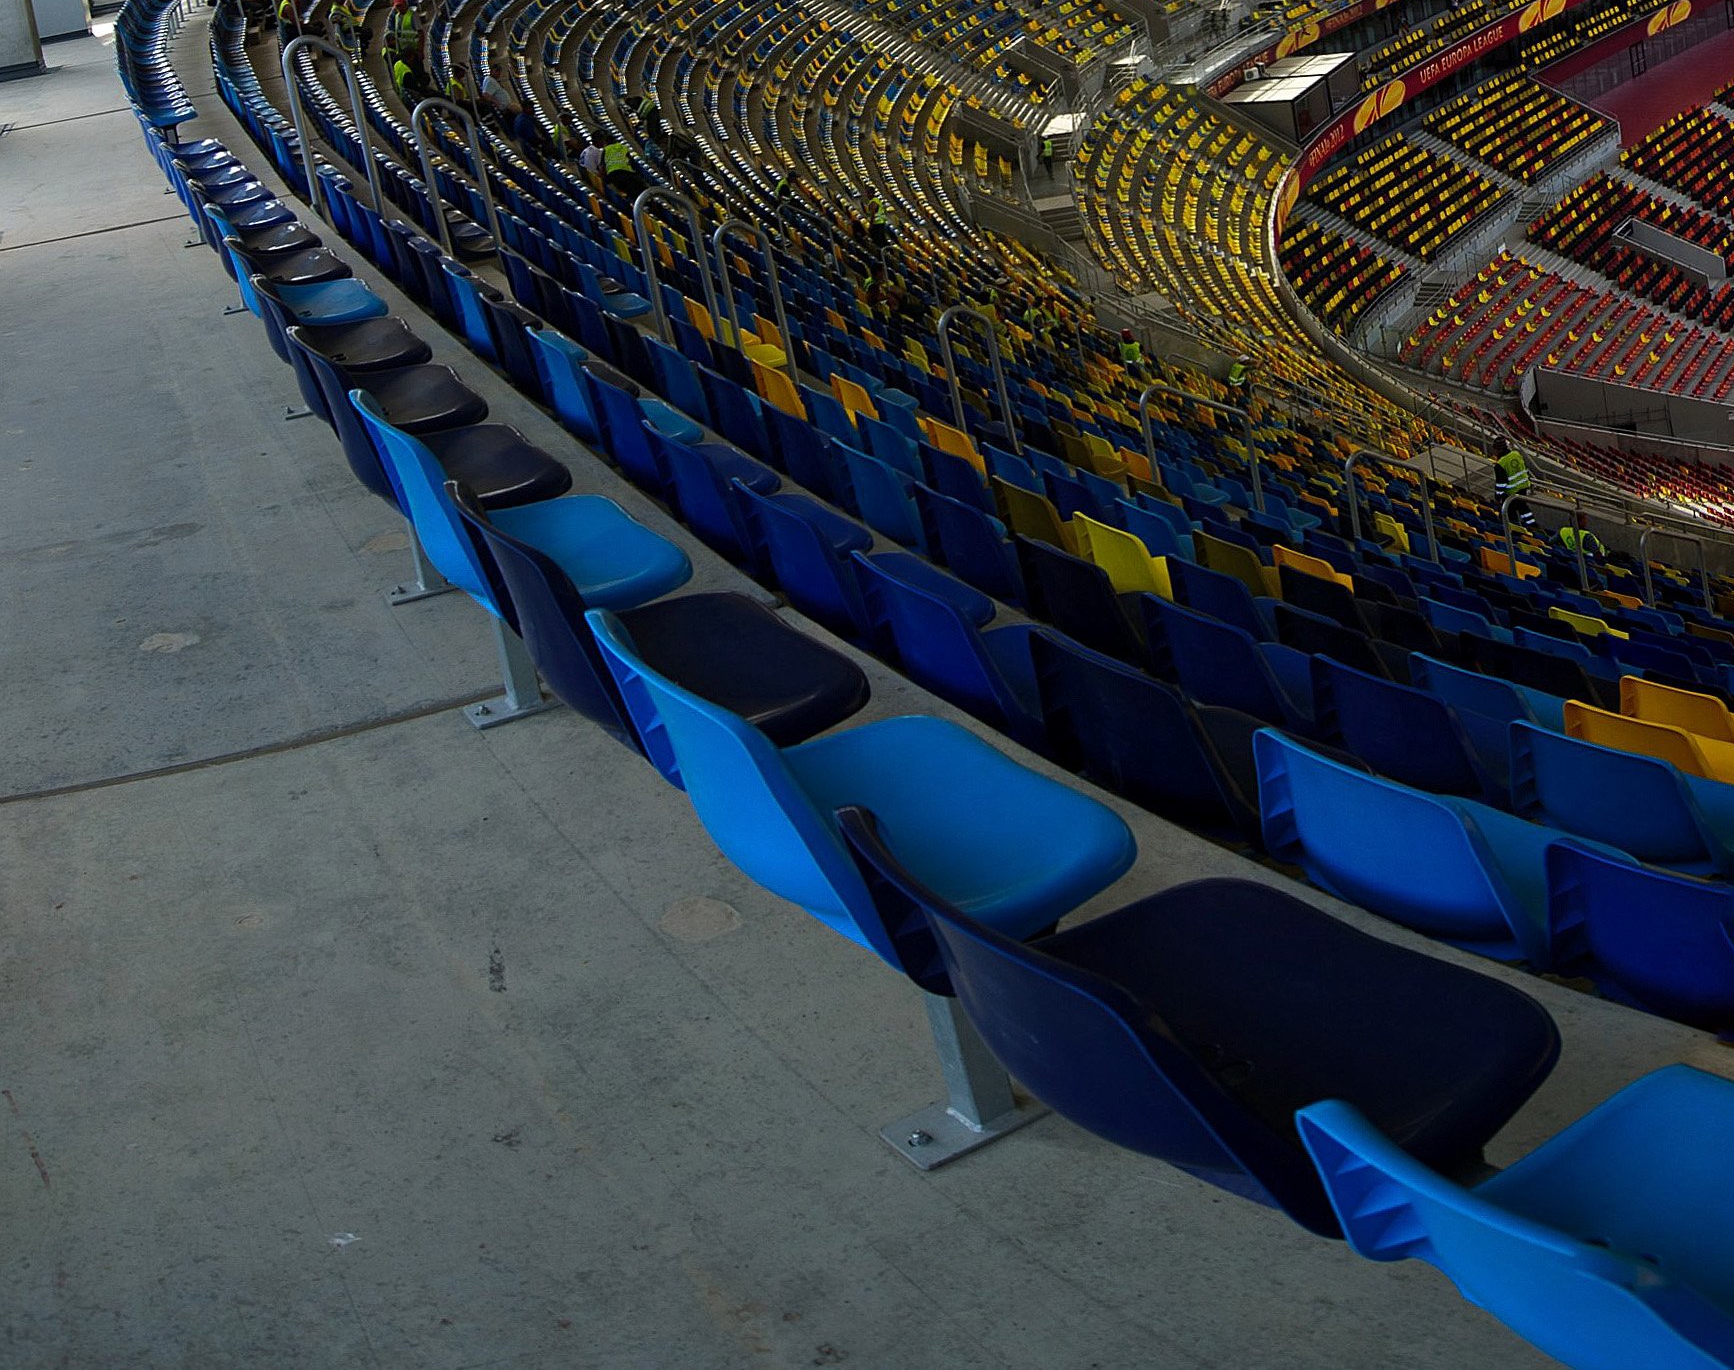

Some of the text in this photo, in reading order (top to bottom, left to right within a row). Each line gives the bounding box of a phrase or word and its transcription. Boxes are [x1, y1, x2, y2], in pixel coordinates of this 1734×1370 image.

[1420, 26, 1503, 83] UEFA EUROPA LEAGUE
[1330, 125, 1345, 150] 2012
